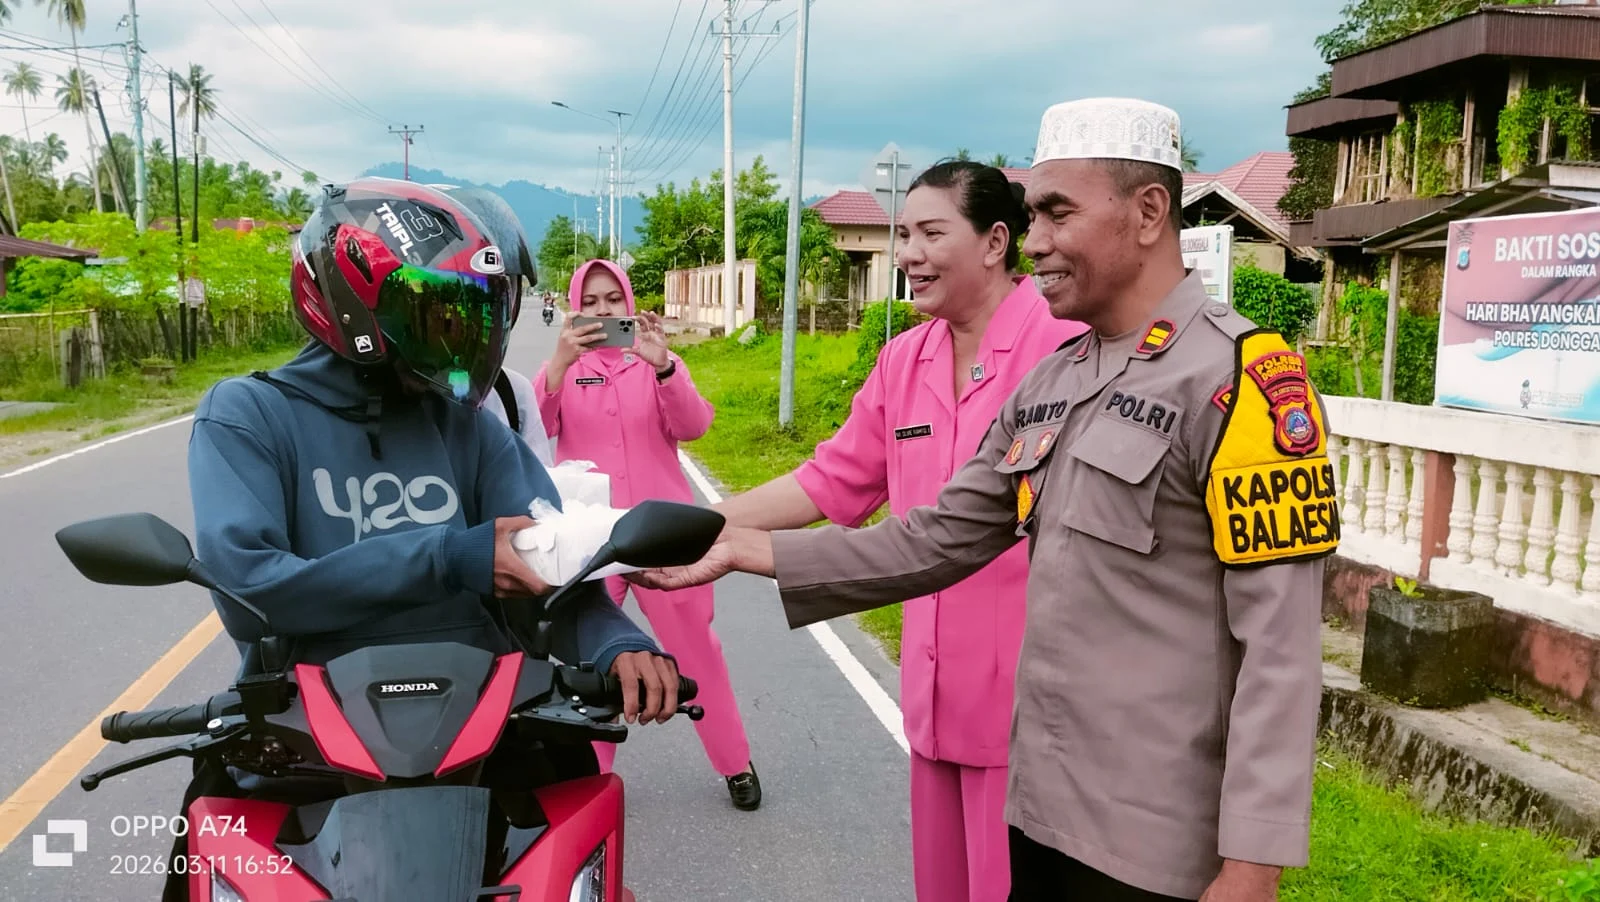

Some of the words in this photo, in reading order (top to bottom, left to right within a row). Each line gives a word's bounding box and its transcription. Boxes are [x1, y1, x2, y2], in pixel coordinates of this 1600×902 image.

[1494, 235, 1553, 262] BAKTI
[1521, 265, 1554, 278] DALAM
[1554, 263, 1597, 278] RANGKA
[1465, 302, 1498, 322] HARI
[1494, 330, 1540, 349] POLRES
[1015, 399, 1068, 430] RAMTO
[1104, 389, 1177, 434] POLRI
[380, 682, 440, 693] HONDA
